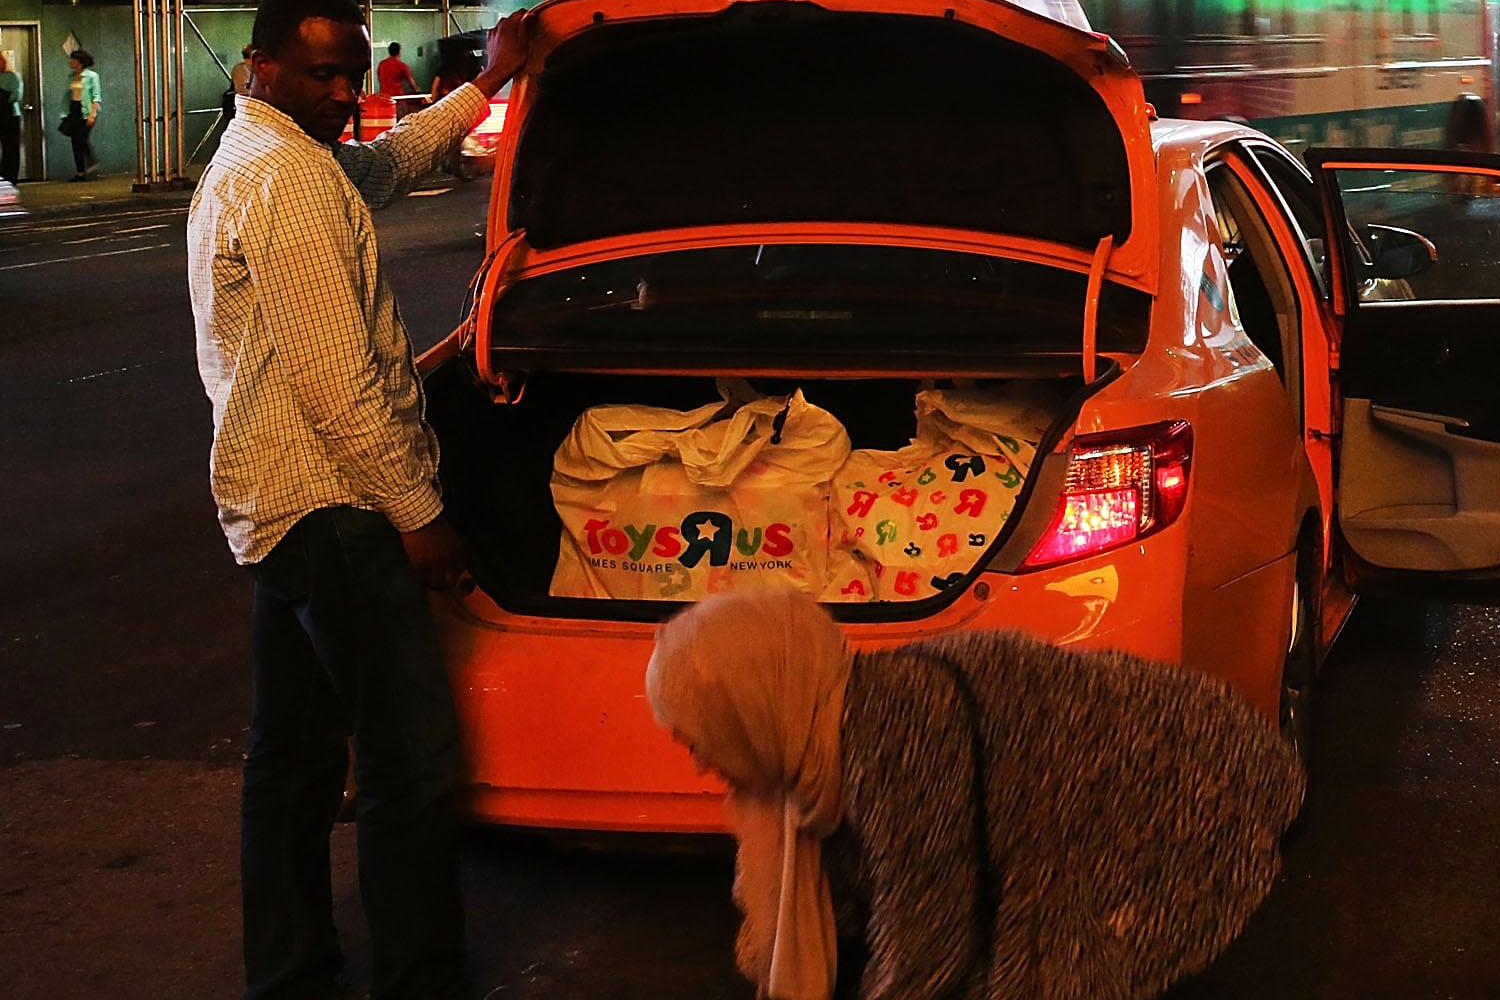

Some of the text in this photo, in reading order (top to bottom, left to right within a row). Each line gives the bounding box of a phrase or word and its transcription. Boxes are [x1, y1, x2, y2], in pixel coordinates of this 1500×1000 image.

[622, 560, 673, 573] SQUARE
[730, 561, 758, 571] NEW
[761, 560, 793, 570] YORK
